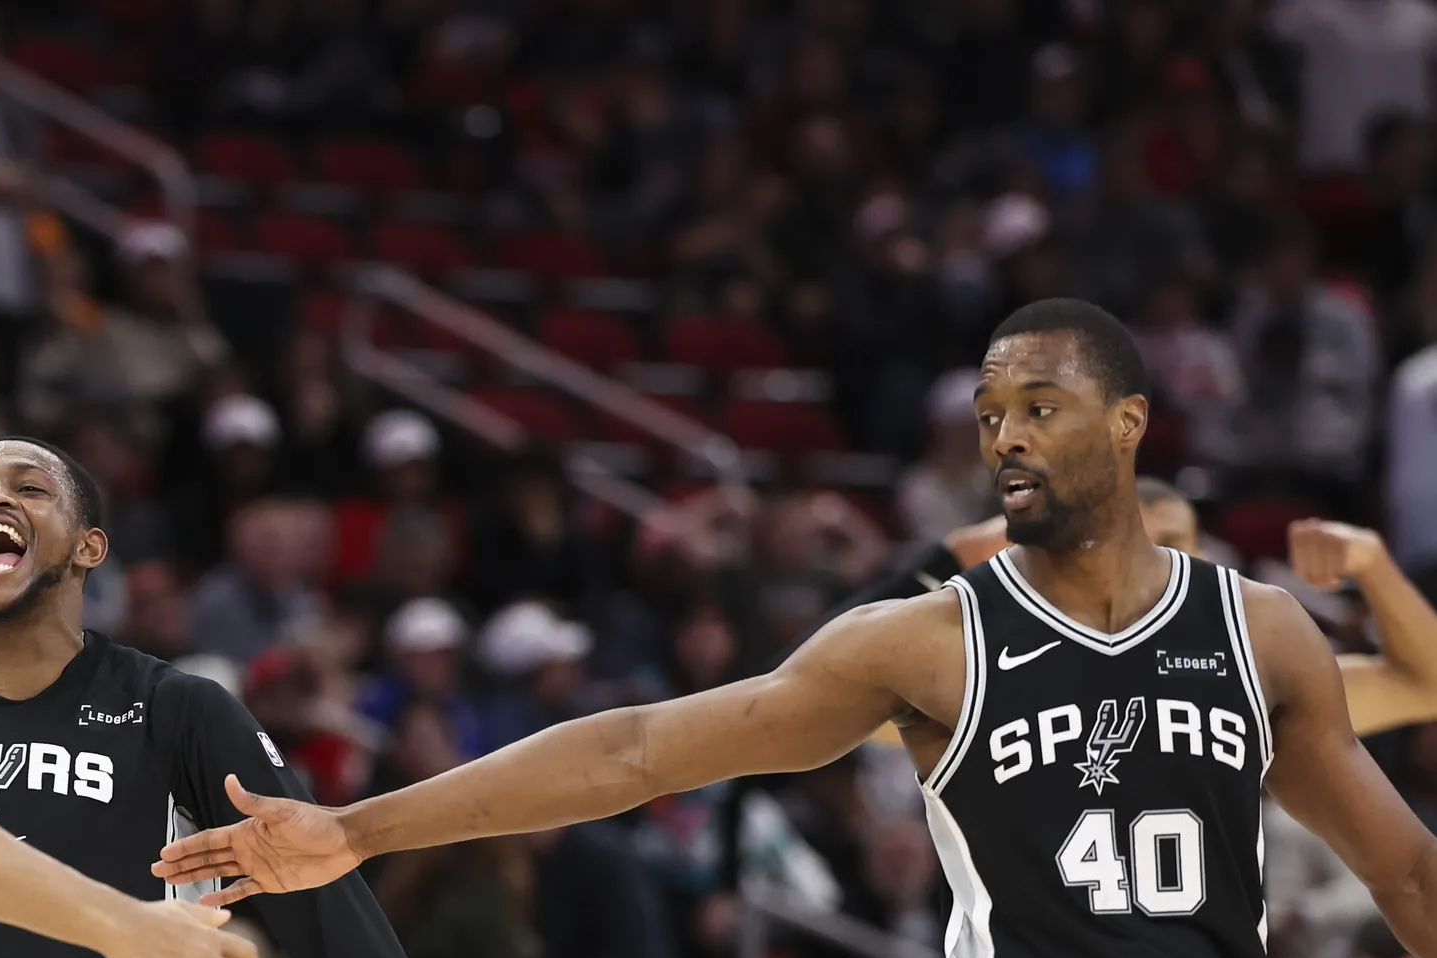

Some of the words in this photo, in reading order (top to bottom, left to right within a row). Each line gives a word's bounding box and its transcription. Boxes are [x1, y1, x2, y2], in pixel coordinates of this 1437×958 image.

[1165, 656, 1218, 670] LEDGER
[87, 708, 135, 725] LEDGER
[989, 696, 1246, 795] SPURS
[1055, 807, 1207, 917] 40
